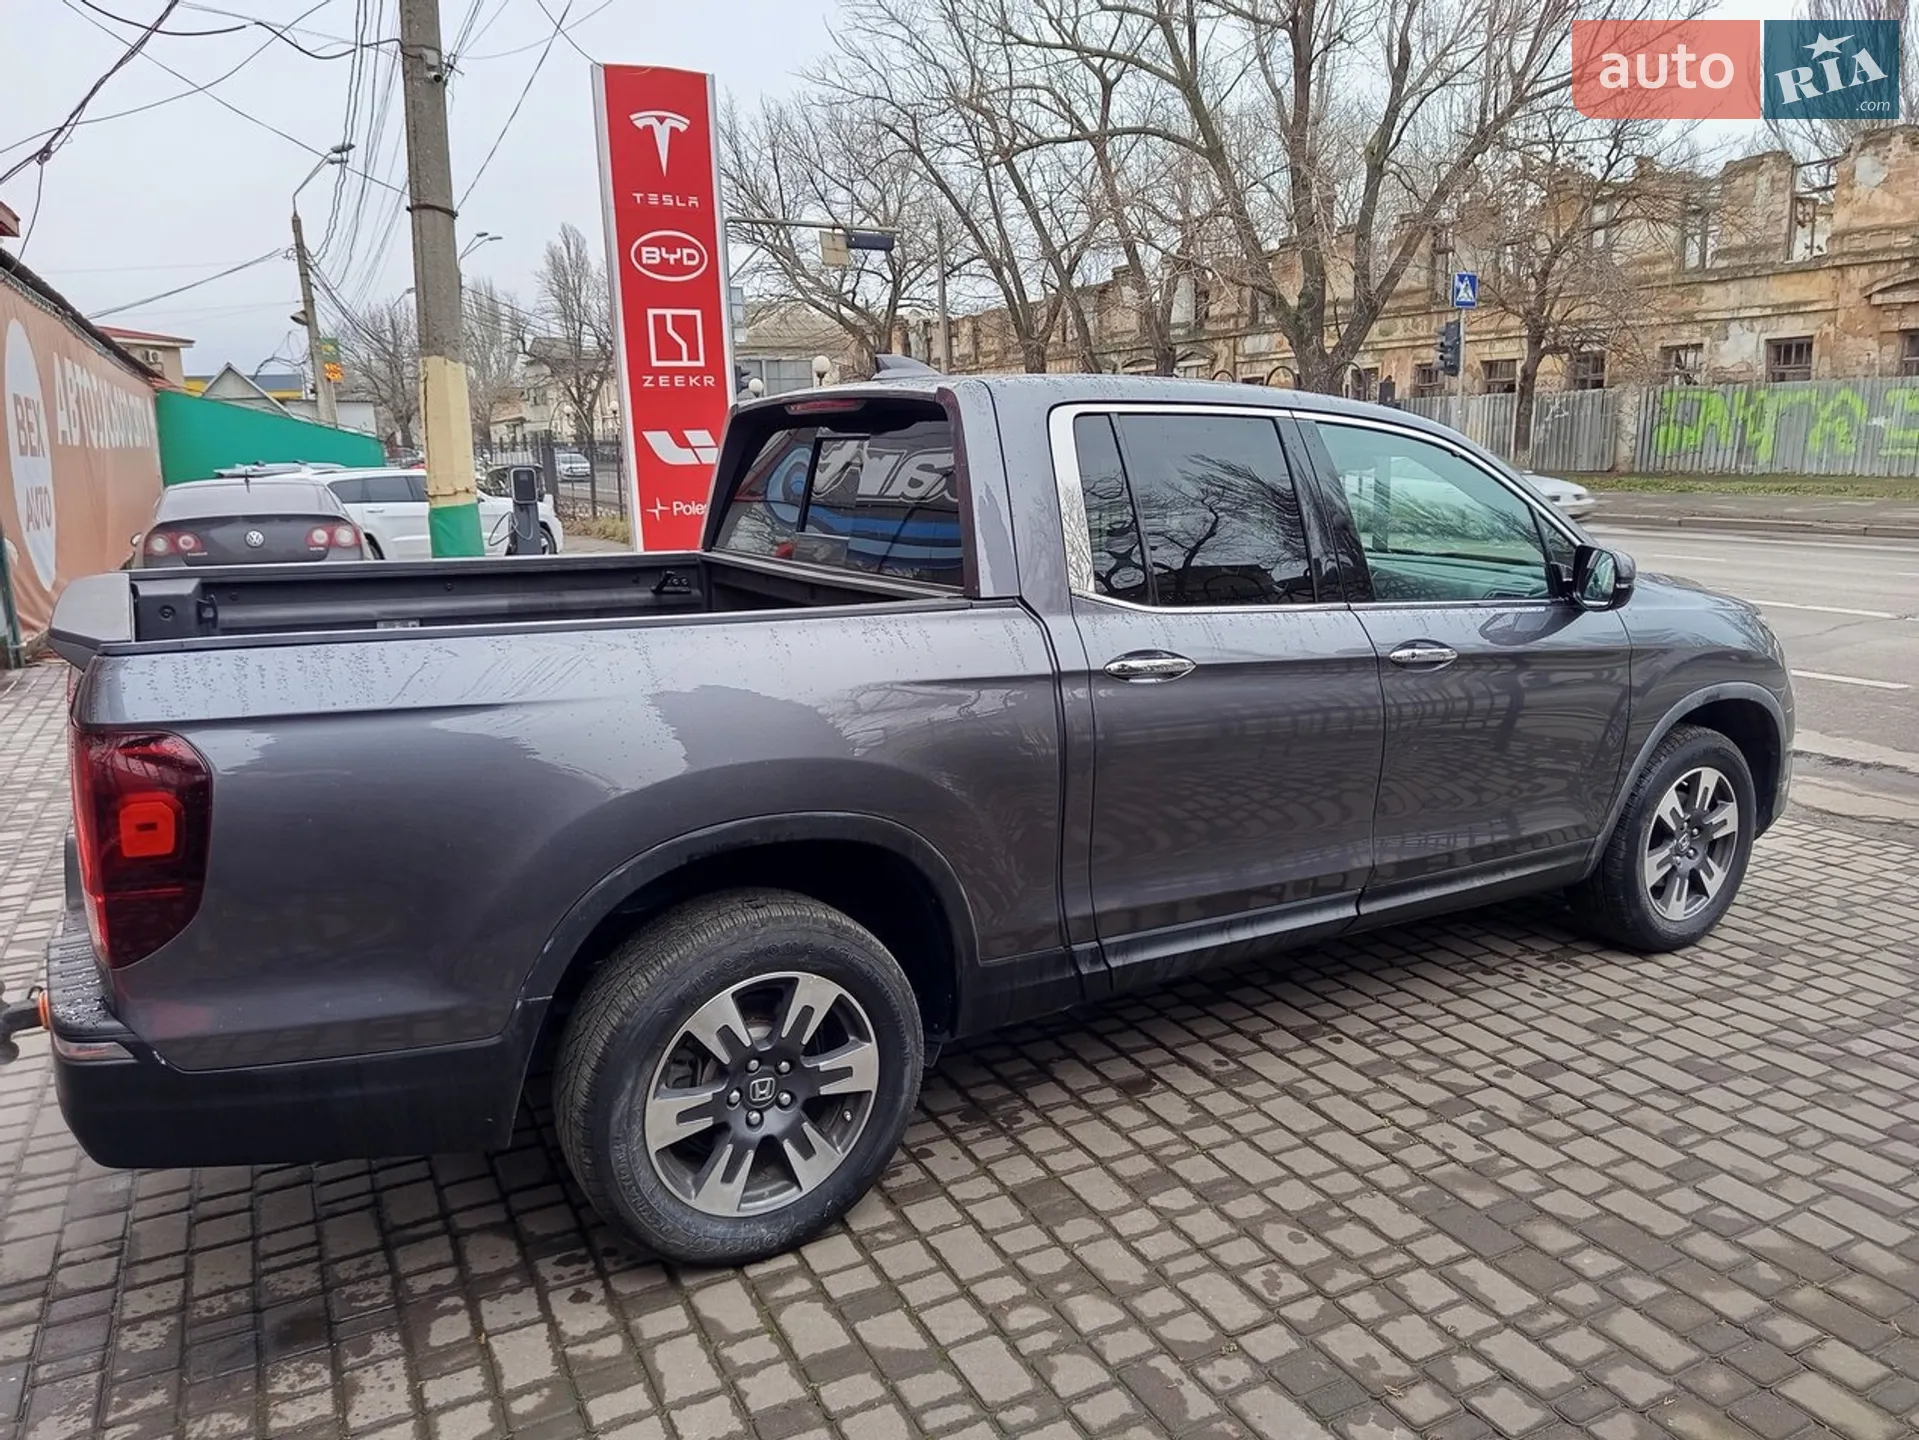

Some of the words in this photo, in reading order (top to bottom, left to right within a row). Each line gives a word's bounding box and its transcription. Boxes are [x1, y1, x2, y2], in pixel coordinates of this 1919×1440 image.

[632, 192, 699, 209] TESLA
[641, 246, 700, 267] BYD
[641, 375, 716, 388] ZEEKR
[672, 500, 707, 517] Pole
